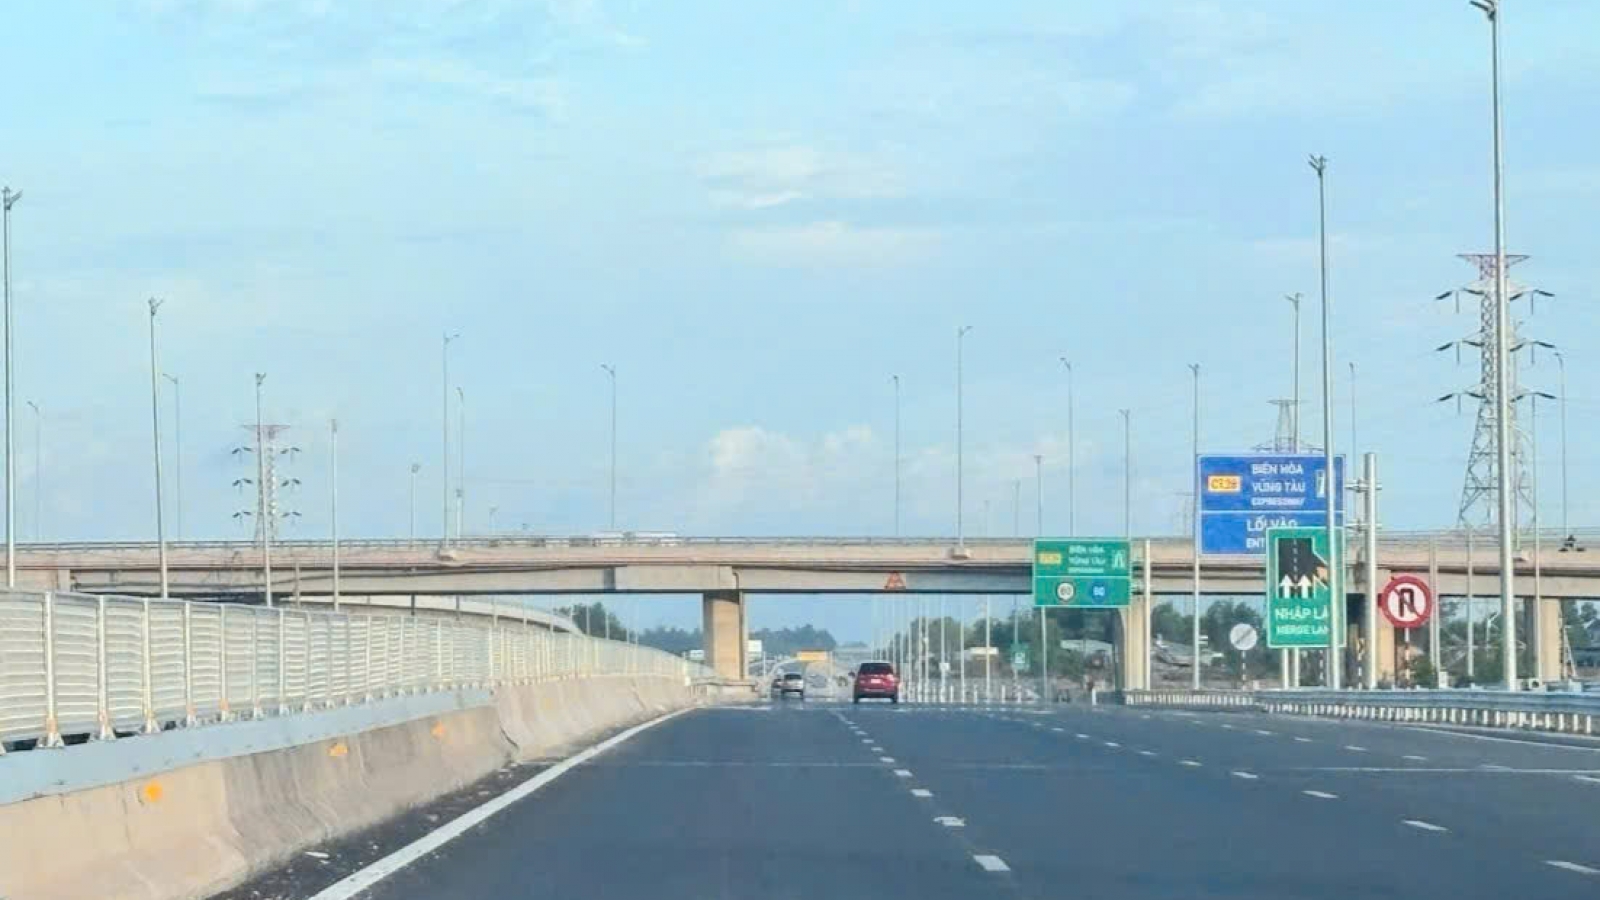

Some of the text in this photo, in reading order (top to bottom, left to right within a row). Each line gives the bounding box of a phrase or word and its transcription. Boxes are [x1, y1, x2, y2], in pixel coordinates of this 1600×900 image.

[1252, 460, 1277, 474] BIÊN
[1284, 479, 1305, 492] TÀU
[1246, 537, 1266, 548] ENT
